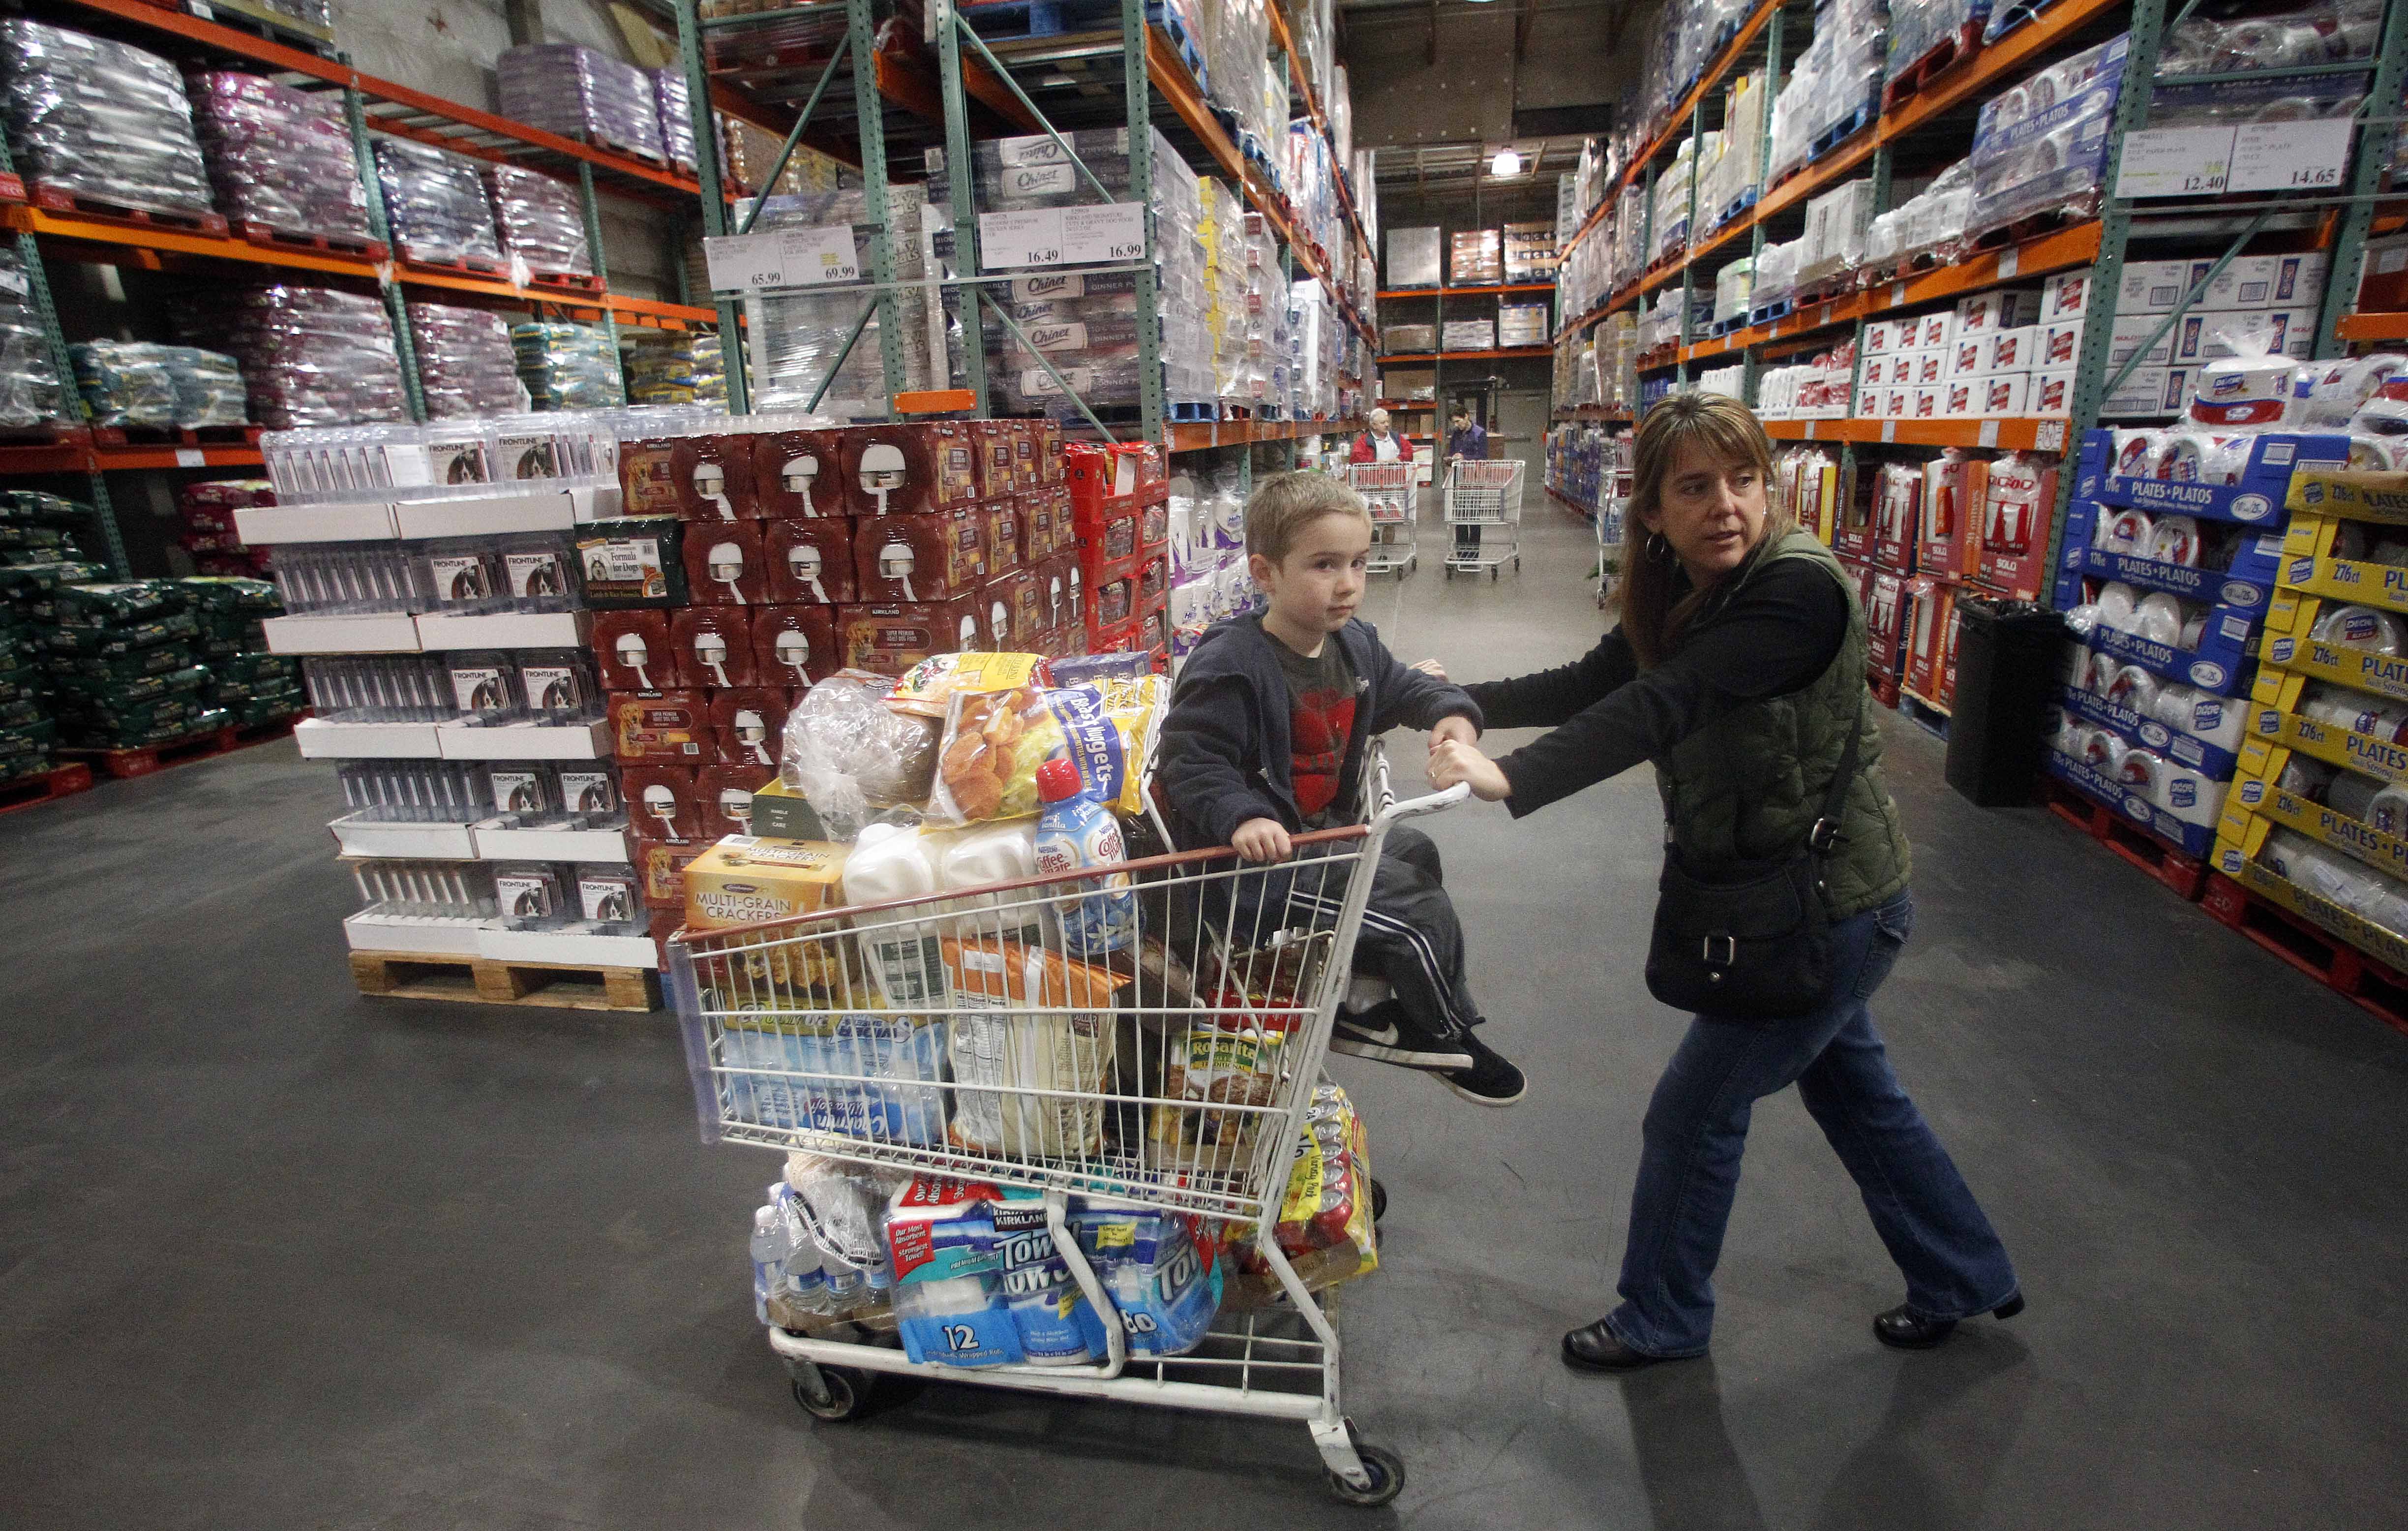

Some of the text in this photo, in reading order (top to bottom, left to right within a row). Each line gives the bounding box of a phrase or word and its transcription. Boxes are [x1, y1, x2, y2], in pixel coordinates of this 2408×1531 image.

[1017, 170, 1057, 186] Chinet
[2184, 175, 2224, 190] 12.40
[2291, 168, 2336, 184] 14.65
[1027, 250, 1058, 263] 16.49
[1110, 245, 1141, 258] 16.99
[752, 272, 781, 285] 65.99
[826, 266, 855, 279] 69.99
[1027, 275, 1067, 291] Chinet
[1031, 327, 1069, 343] Chinet
[429, 444, 465, 452] FRONTLINE
[499, 437, 536, 446] FRONTLINE
[2131, 481, 2166, 497] PLATES
[2171, 487, 2212, 504] PLATOS
[611, 552, 636, 561] Formula
[613, 562, 639, 573] for Dogs
[1996, 558, 2017, 571] SOLO
[2119, 557, 2152, 576] PLATES
[2158, 566, 2201, 587] PLATOS
[2136, 641, 2173, 664] PLATOS
[1084, 726, 1114, 783] Nuggets
[2346, 735, 2407, 770] PLATES
[2320, 812, 2378, 851] PLATES
[746, 846, 831, 858] MULTI-GRAIN
[750, 852, 816, 862] CRACKERS
[695, 893, 791, 911] MULTI-GRAIN
[895, 1230, 926, 1245] Absorbent
[896, 1224, 923, 1236] Our Most
[898, 1242, 929, 1257] Strongest
[941, 1323, 979, 1351] 12
